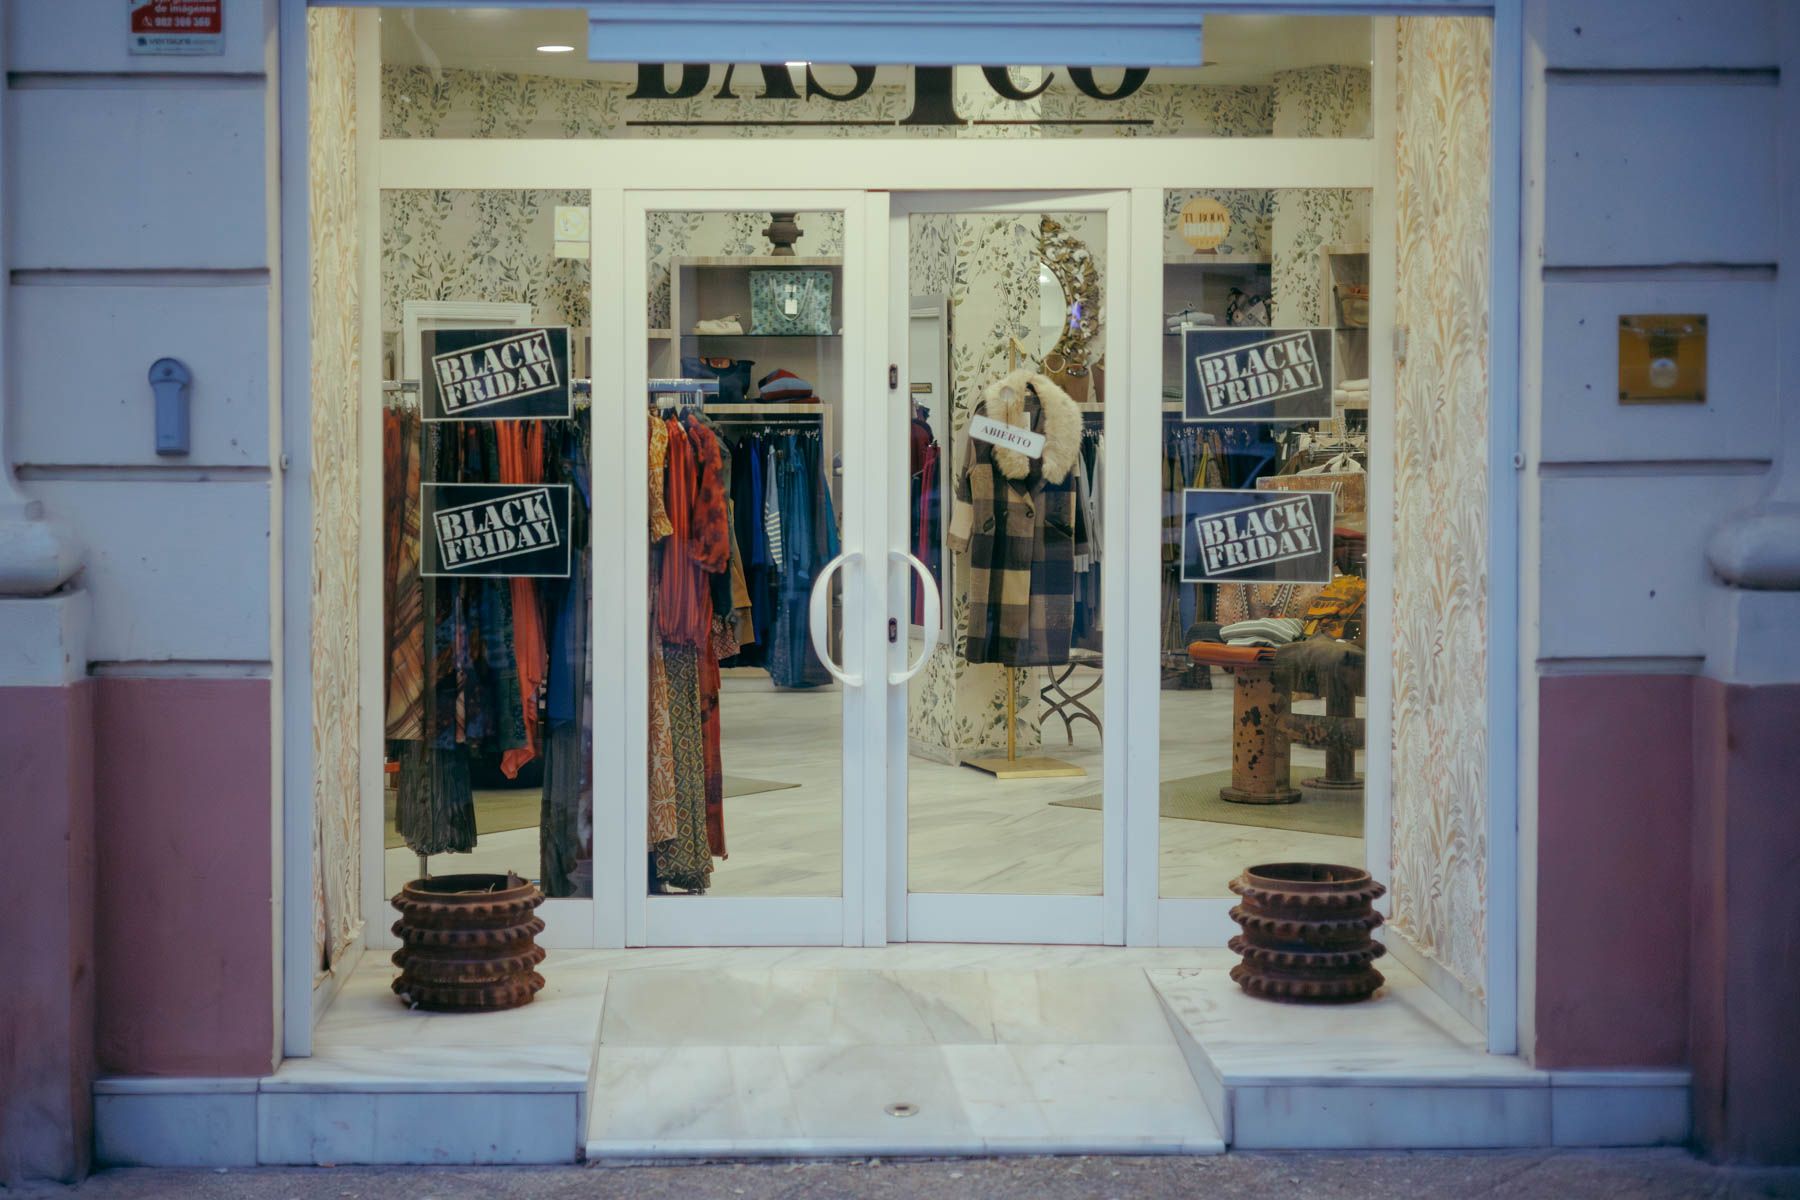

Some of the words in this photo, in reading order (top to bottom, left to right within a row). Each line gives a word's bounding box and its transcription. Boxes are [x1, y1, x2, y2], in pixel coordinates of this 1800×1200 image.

[437, 335, 549, 386] BLACK
[1201, 337, 1313, 387] BLACK
[443, 361, 551, 409] FRIDAY
[1207, 362, 1316, 410] FRIDAY
[981, 425, 1031, 448] ABIERTO
[438, 494, 550, 541] BLACK
[1201, 501, 1312, 547] BLACK
[444, 520, 551, 564] FRIDAY
[1206, 526, 1313, 570] FRIDAY
